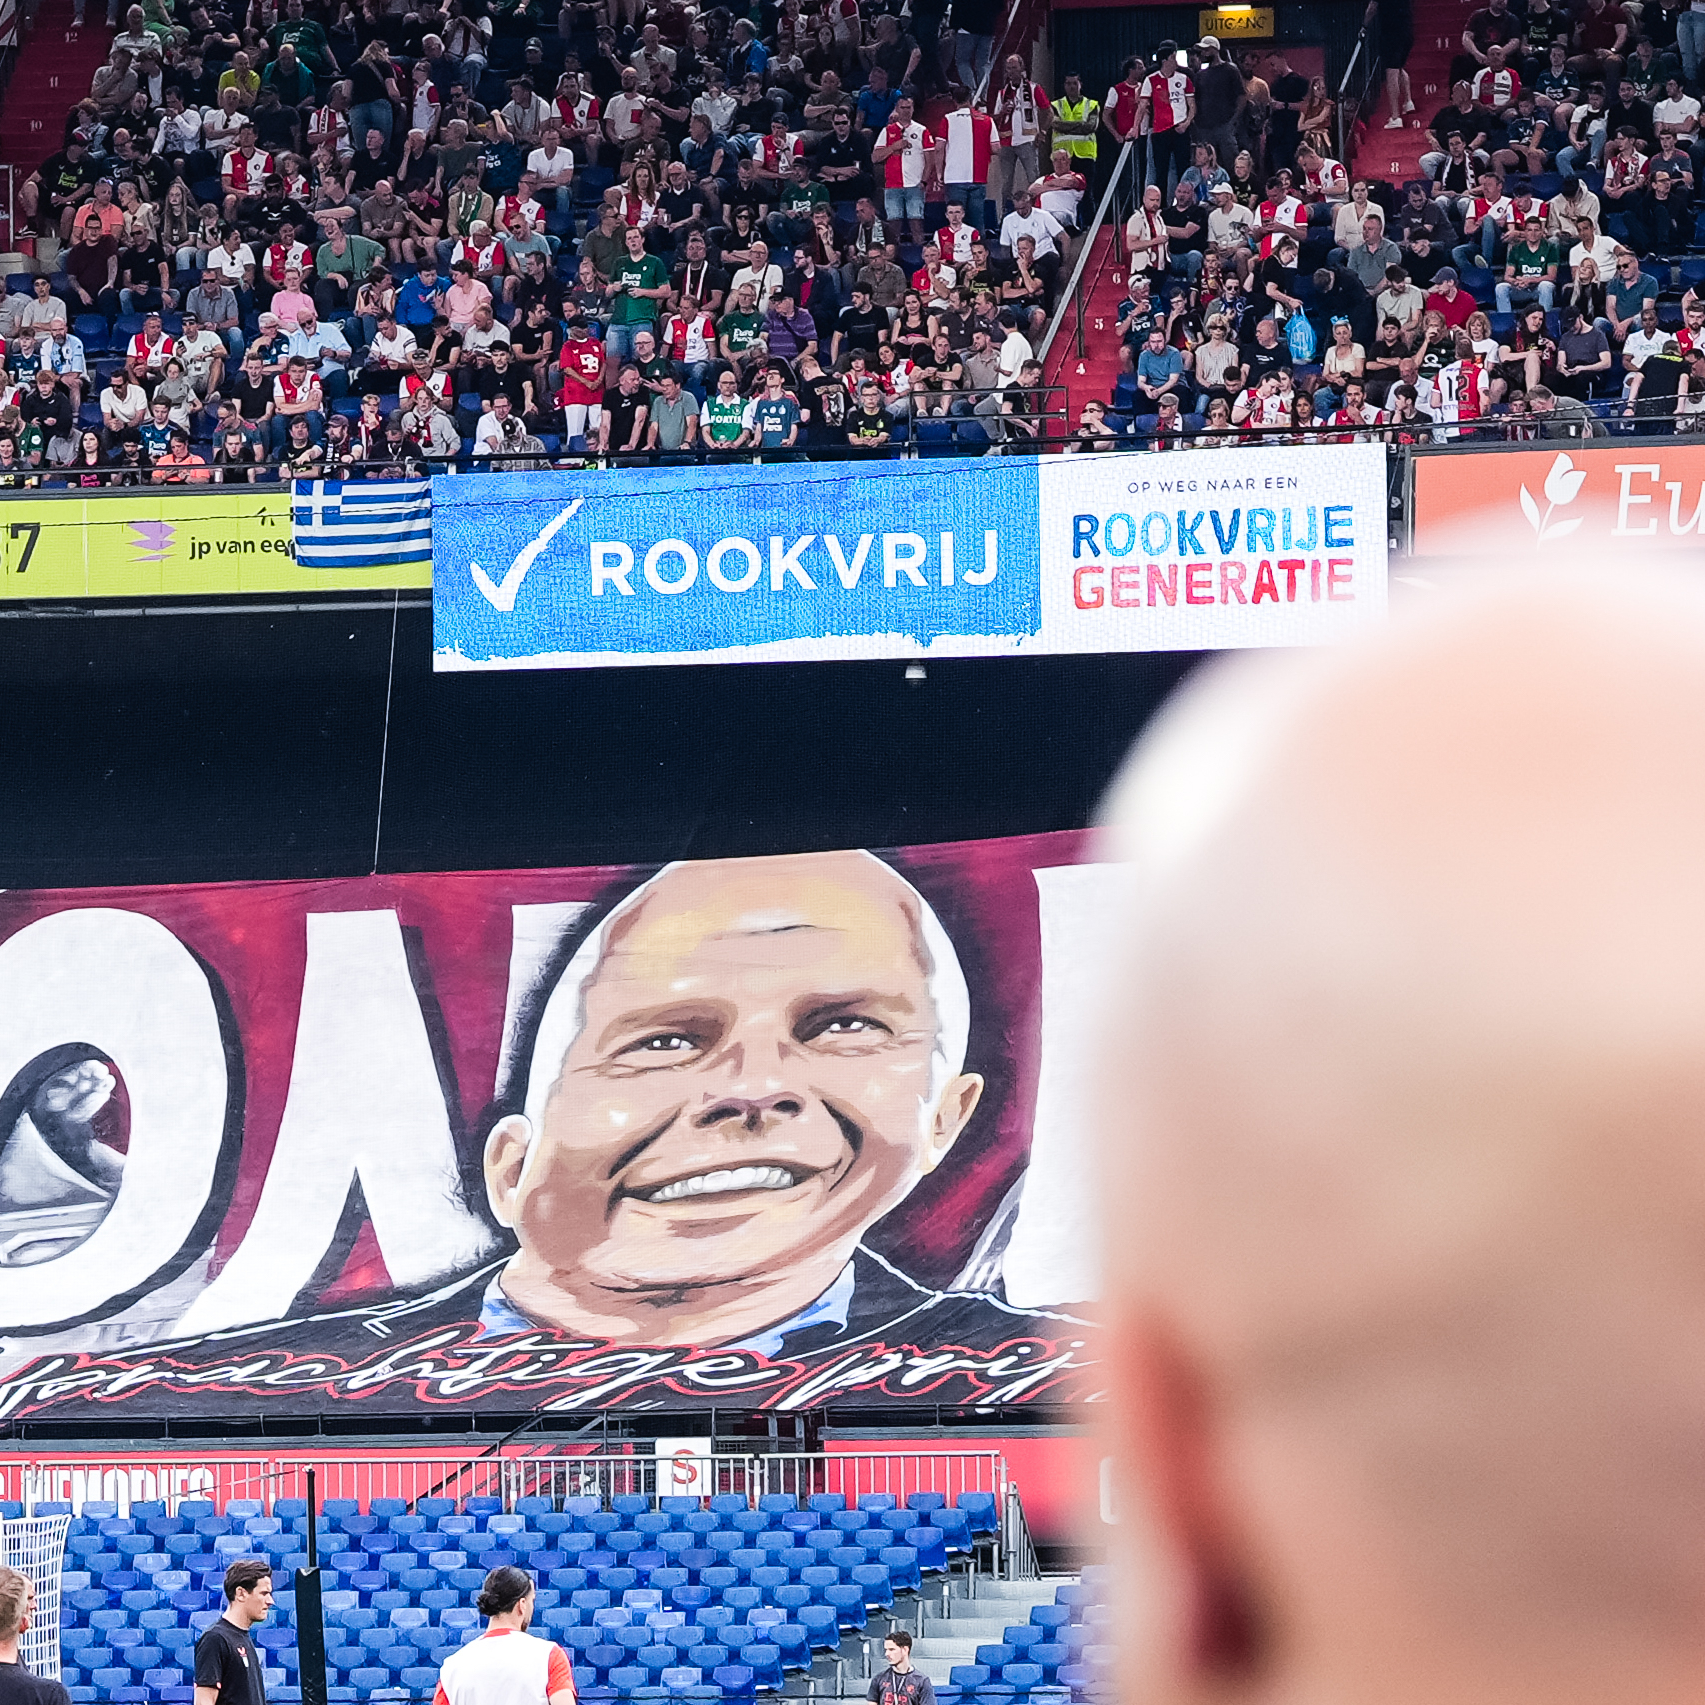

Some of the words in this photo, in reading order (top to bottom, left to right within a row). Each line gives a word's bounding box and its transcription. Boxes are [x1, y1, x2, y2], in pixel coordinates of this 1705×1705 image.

[1112, 273, 1121, 284] 6
[1094, 317, 1104, 330] 5
[1075, 362, 1086, 374] 4
[1446, 376, 1468, 401] 12
[1127, 481, 1151, 494] OP
[1159, 480, 1198, 493] WEG
[1207, 478, 1256, 492] NAAR
[1264, 476, 1299, 490] EEN
[1072, 505, 1355, 559] ROOKVRIJE
[189, 536, 211, 562] jp
[216, 540, 256, 555] van
[591, 529, 1000, 597] ROOKVRIJ
[1072, 558, 1357, 610] GENERATIE
[672, 1448, 698, 1485] S
[25, 1467, 215, 1516] MEMORIES
